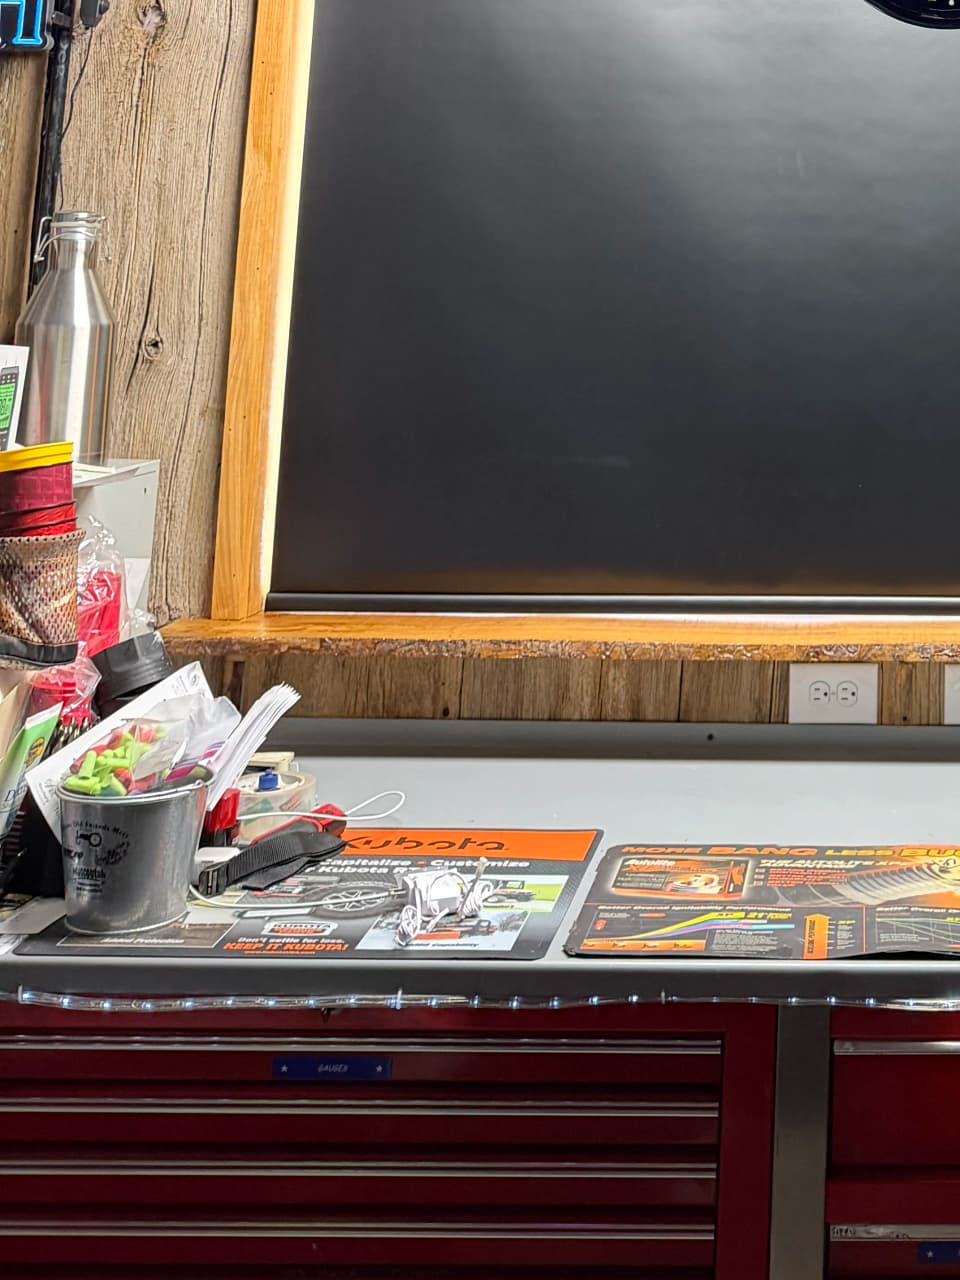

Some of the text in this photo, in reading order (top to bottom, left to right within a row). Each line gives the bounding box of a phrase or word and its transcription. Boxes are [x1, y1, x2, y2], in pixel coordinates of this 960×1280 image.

[621, 846, 703, 854] MORE
[707, 846, 819, 856] BANG
[825, 848, 895, 856] LESS
[429, 858, 531, 870] Customize
[318, 865, 391, 874] Kubota
[223, 942, 264, 951] KEEP
[283, 943, 349, 951] KUBOTA!
